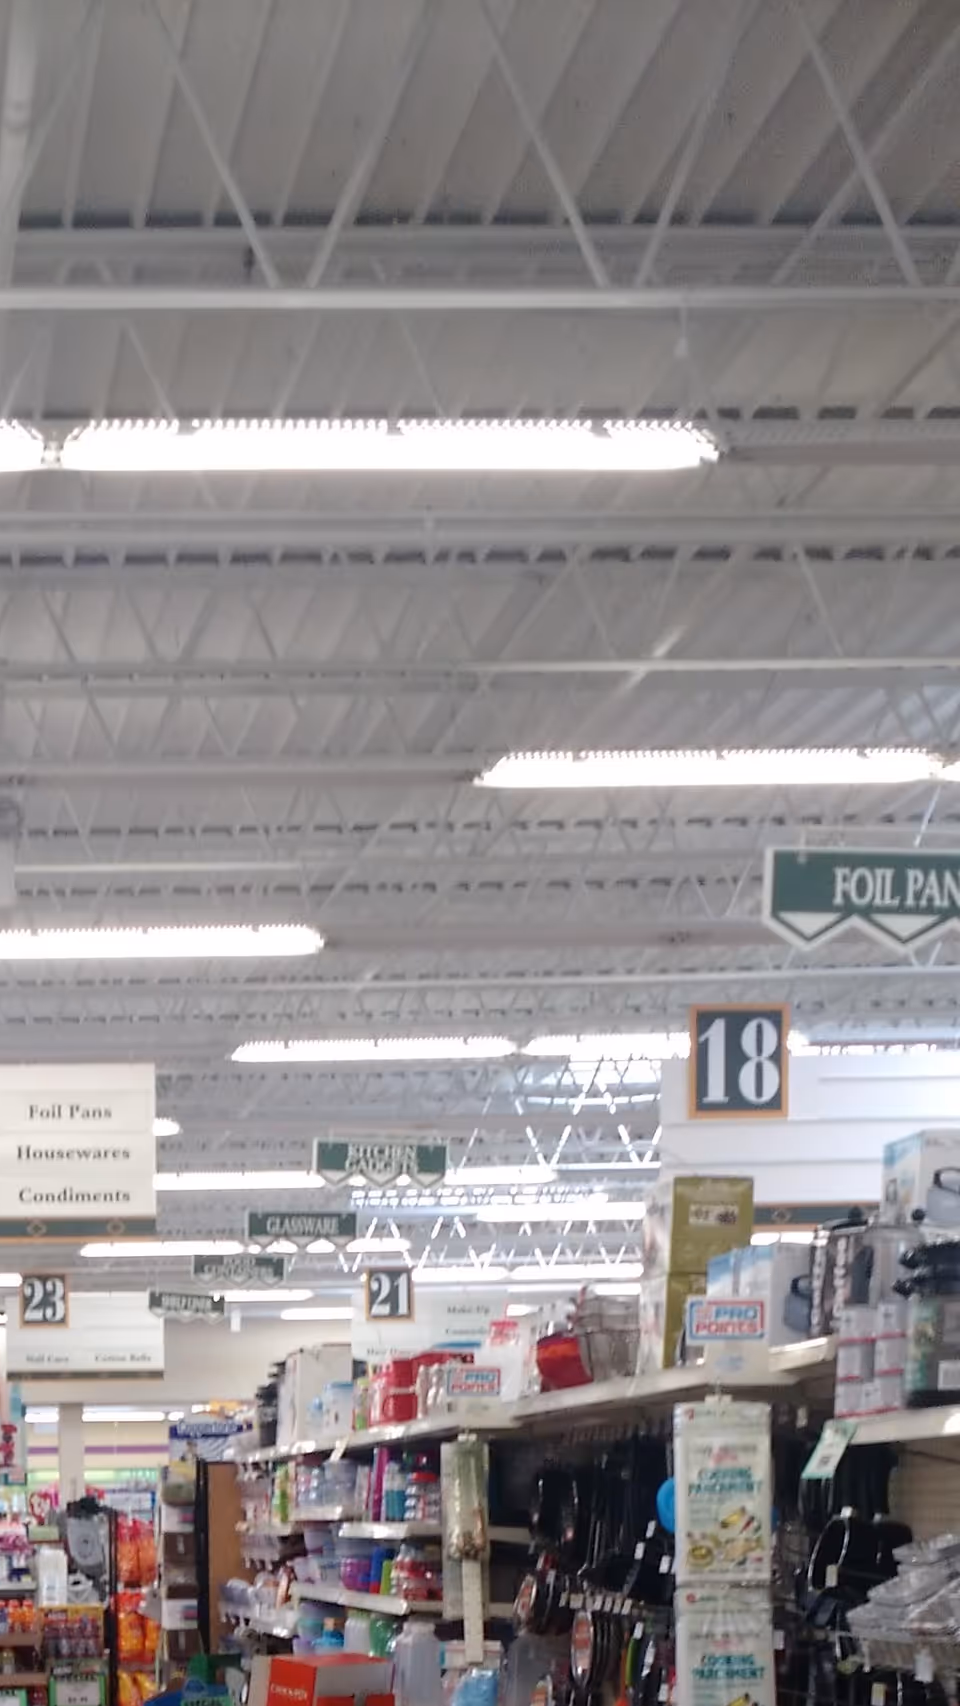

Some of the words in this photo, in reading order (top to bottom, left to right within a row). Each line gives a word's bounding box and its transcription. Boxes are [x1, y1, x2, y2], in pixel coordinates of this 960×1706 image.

[833, 866, 901, 907] FOIL
[698, 1017, 779, 1104] 18
[28, 1104, 63, 1120] Foil
[69, 1104, 112, 1120] Pans
[16, 1145, 130, 1161] Housewares
[18, 1186, 130, 1204] Condiments
[267, 1217, 339, 1235] GLASSWARE
[23, 1277, 66, 1322] 23
[370, 1272, 409, 1315] 21
